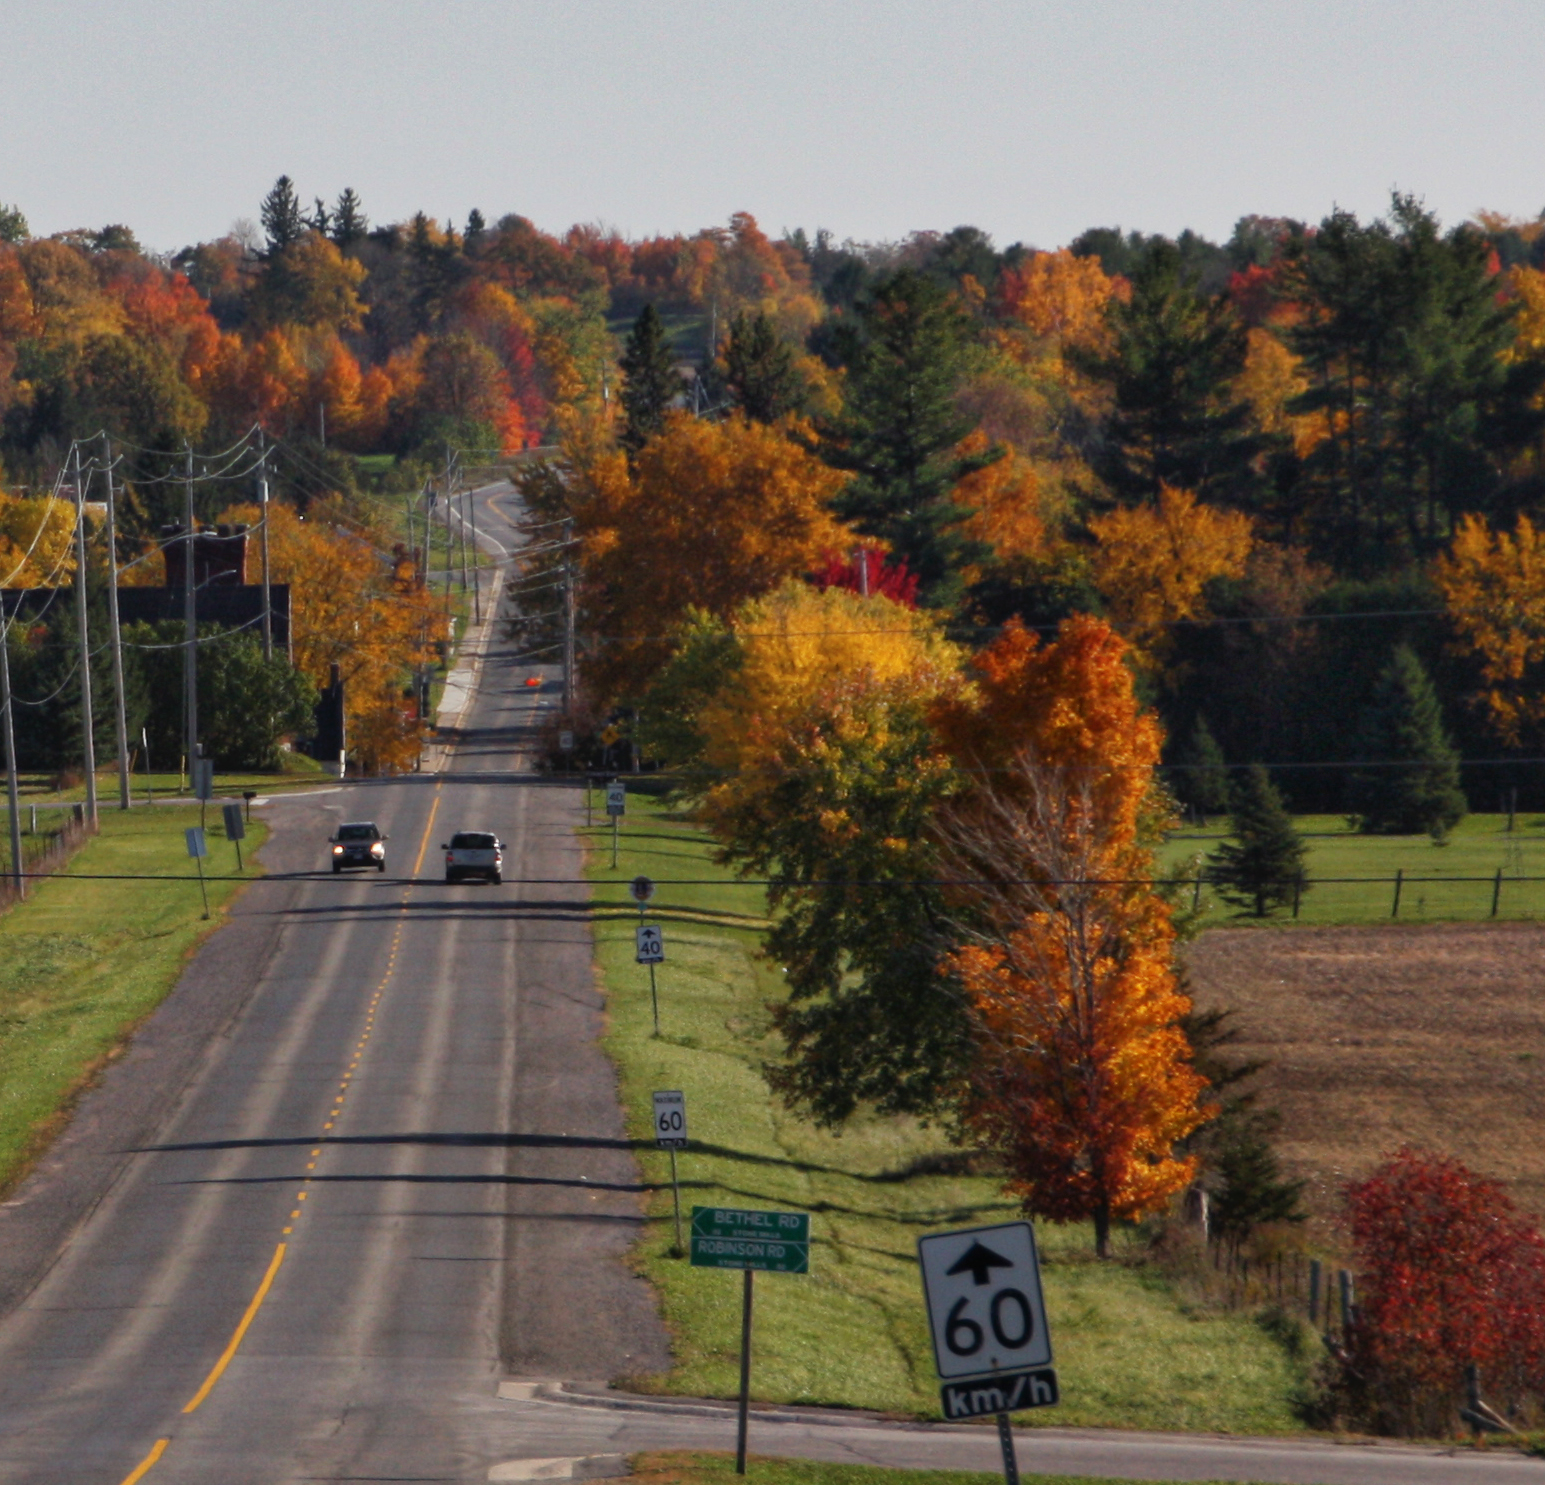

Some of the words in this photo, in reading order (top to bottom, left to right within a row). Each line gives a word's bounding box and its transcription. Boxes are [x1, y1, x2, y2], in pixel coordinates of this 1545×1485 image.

[640, 940, 660, 955] 40
[659, 1111, 682, 1131] 60
[715, 1211, 773, 1227] BETHEL
[778, 1214, 800, 1228] RD
[698, 1240, 765, 1256] ROBINSON
[767, 1245, 786, 1258] RD
[945, 1288, 1034, 1357] 60
[947, 1375, 1053, 1417] km/h
